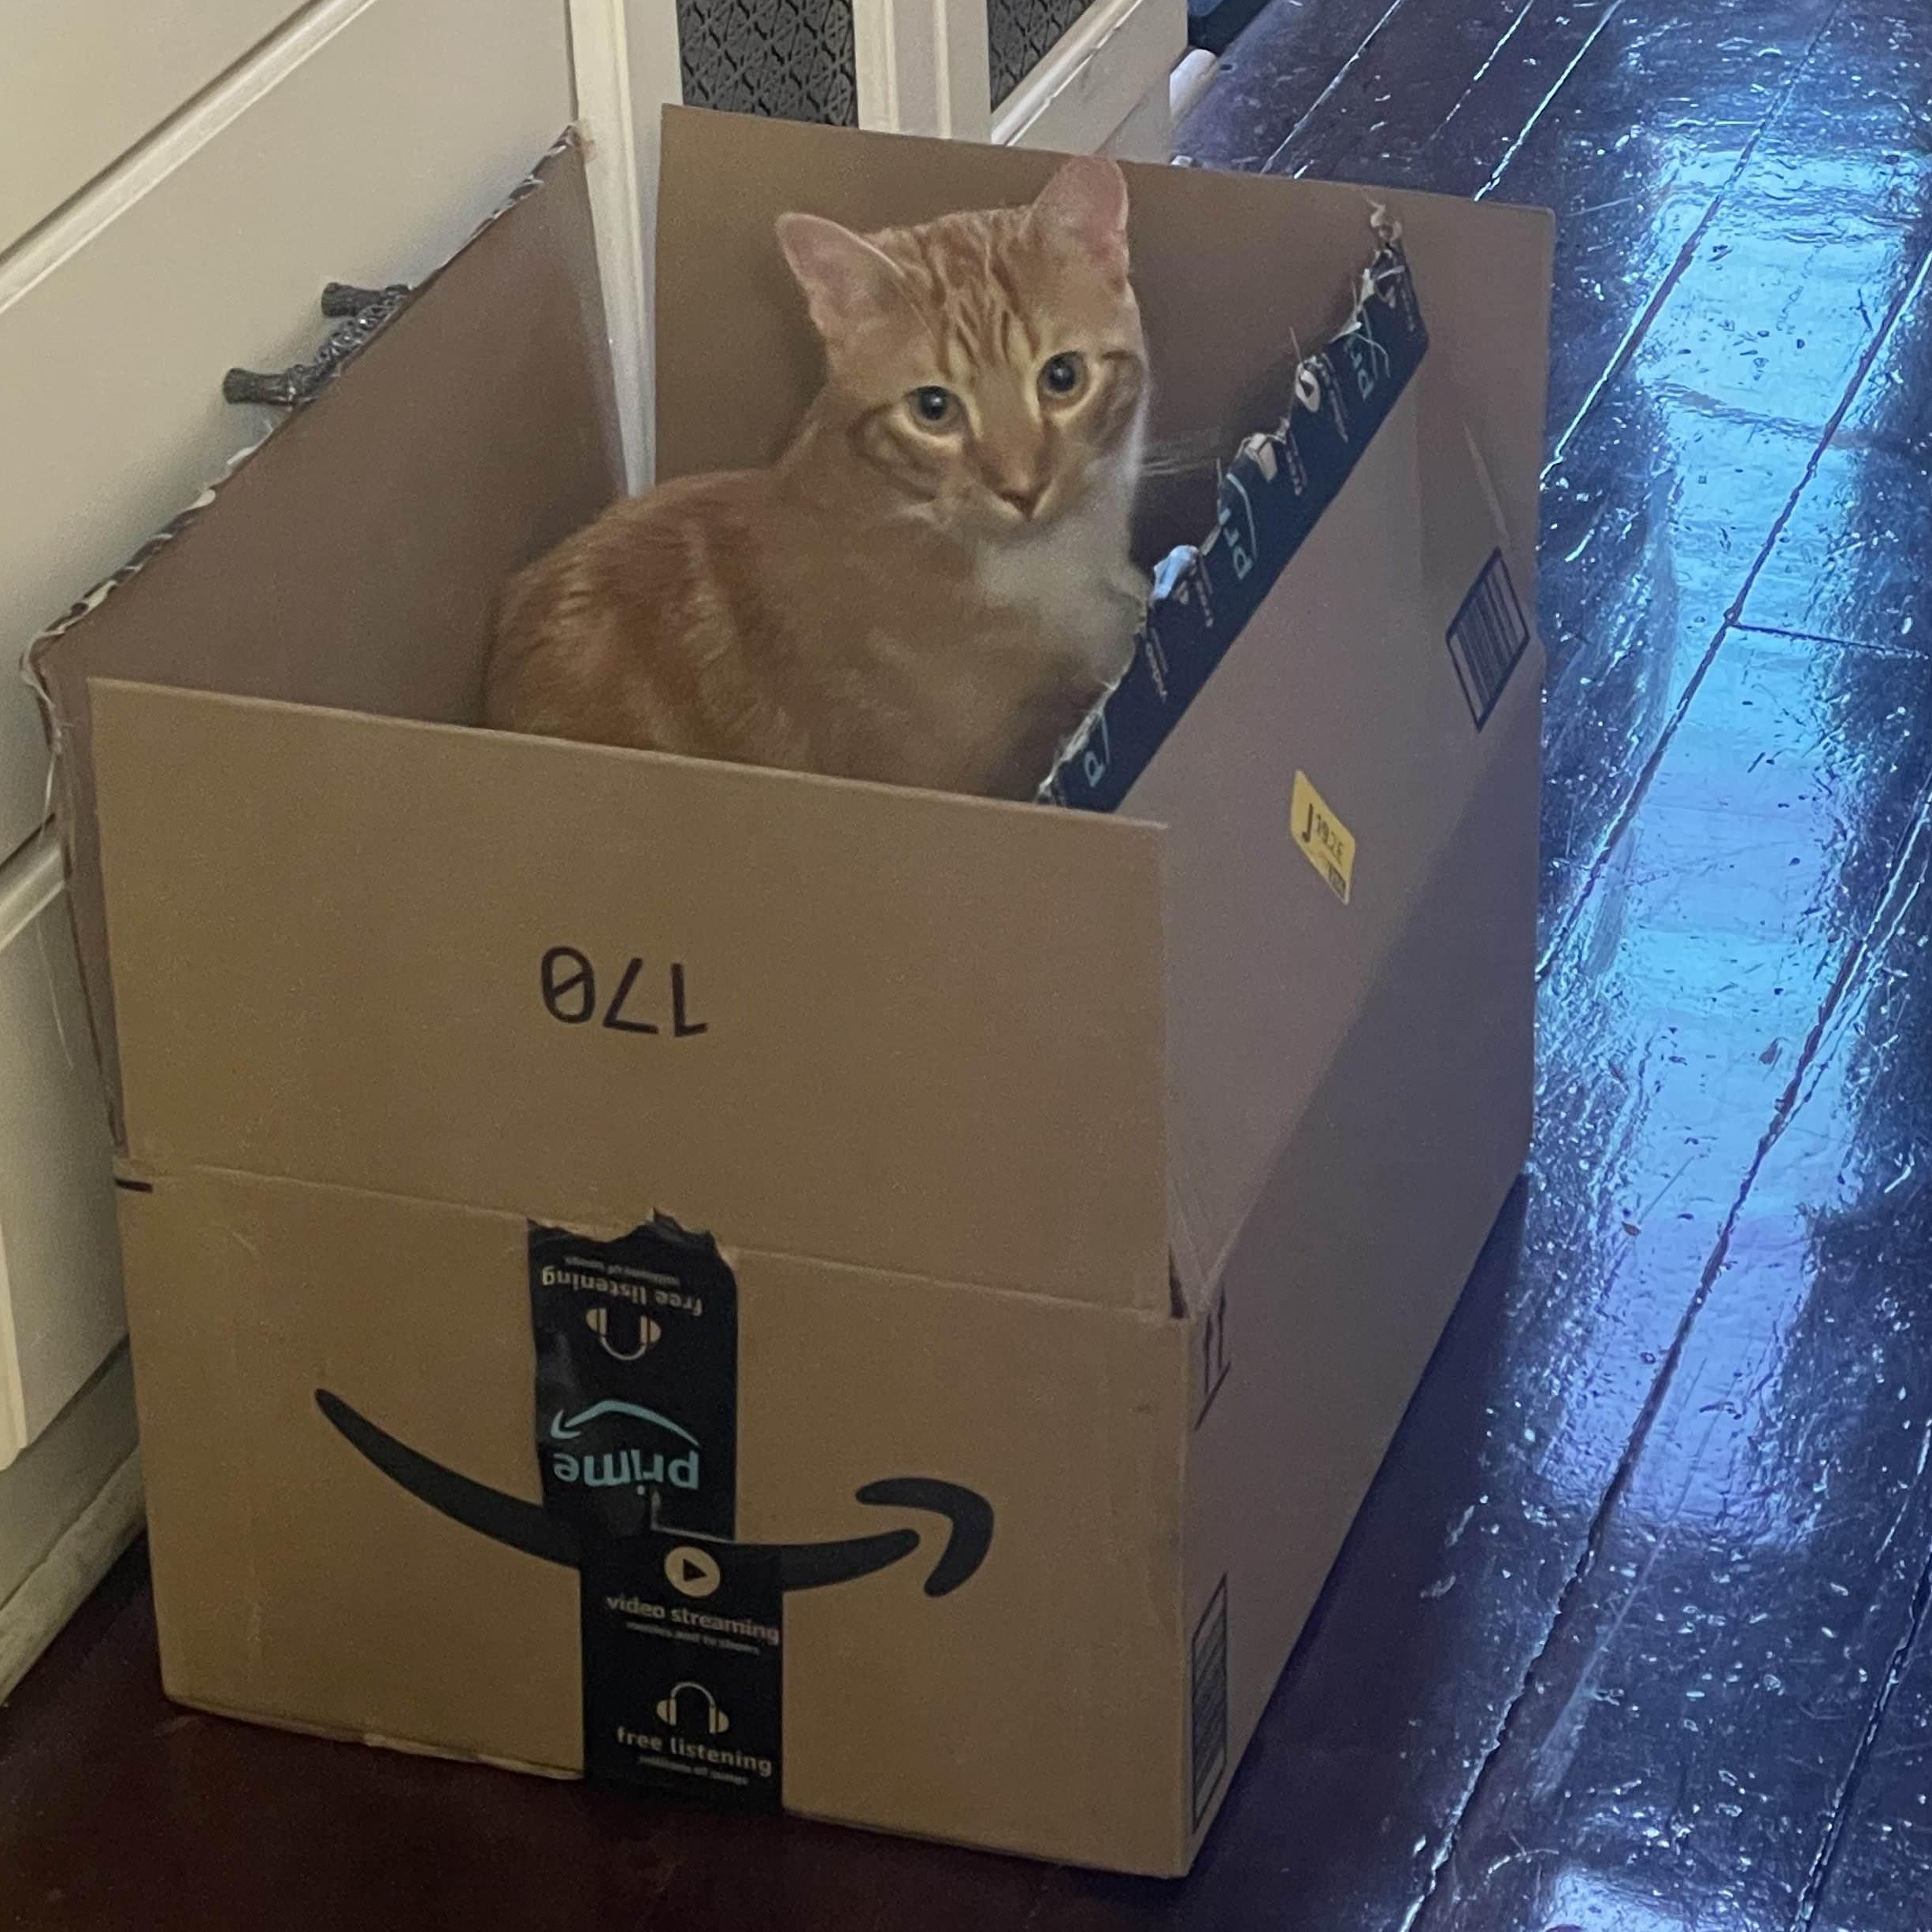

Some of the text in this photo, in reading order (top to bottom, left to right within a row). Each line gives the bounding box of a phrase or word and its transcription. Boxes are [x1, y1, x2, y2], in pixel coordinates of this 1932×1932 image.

[541, 947, 708, 1038] 170
[542, 1265, 647, 1306] listening
[655, 1290, 703, 1317] free
[553, 1448, 700, 1496] prime
[606, 1593, 665, 1619] video
[670, 1607, 780, 1646] streaming
[617, 1725, 663, 1752] free
[669, 1736, 773, 1778] listening
